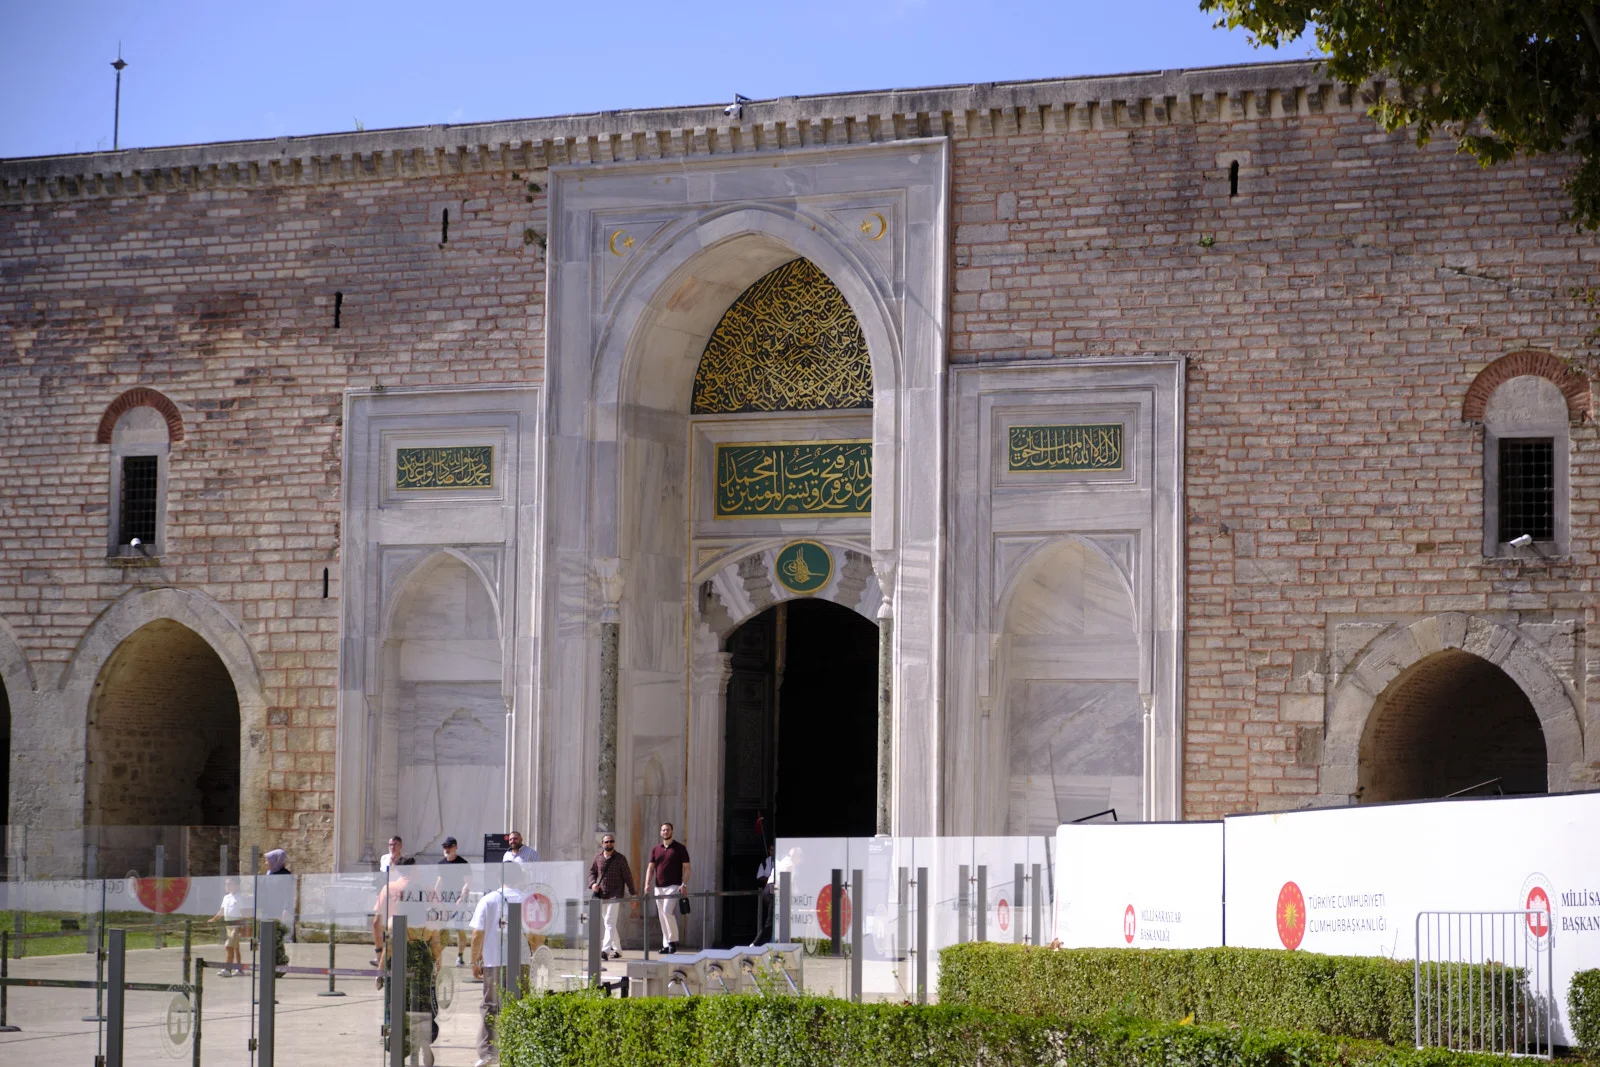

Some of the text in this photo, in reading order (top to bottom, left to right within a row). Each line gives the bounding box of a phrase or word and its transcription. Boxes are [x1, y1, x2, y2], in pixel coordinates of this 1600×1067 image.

[1309, 891, 1386, 909] TÜRKİYE CUMHURİYETİ
[1561, 889, 1588, 906] MİLLİ
[1309, 915, 1387, 935] CUMHURBAŞKANLIĞI
